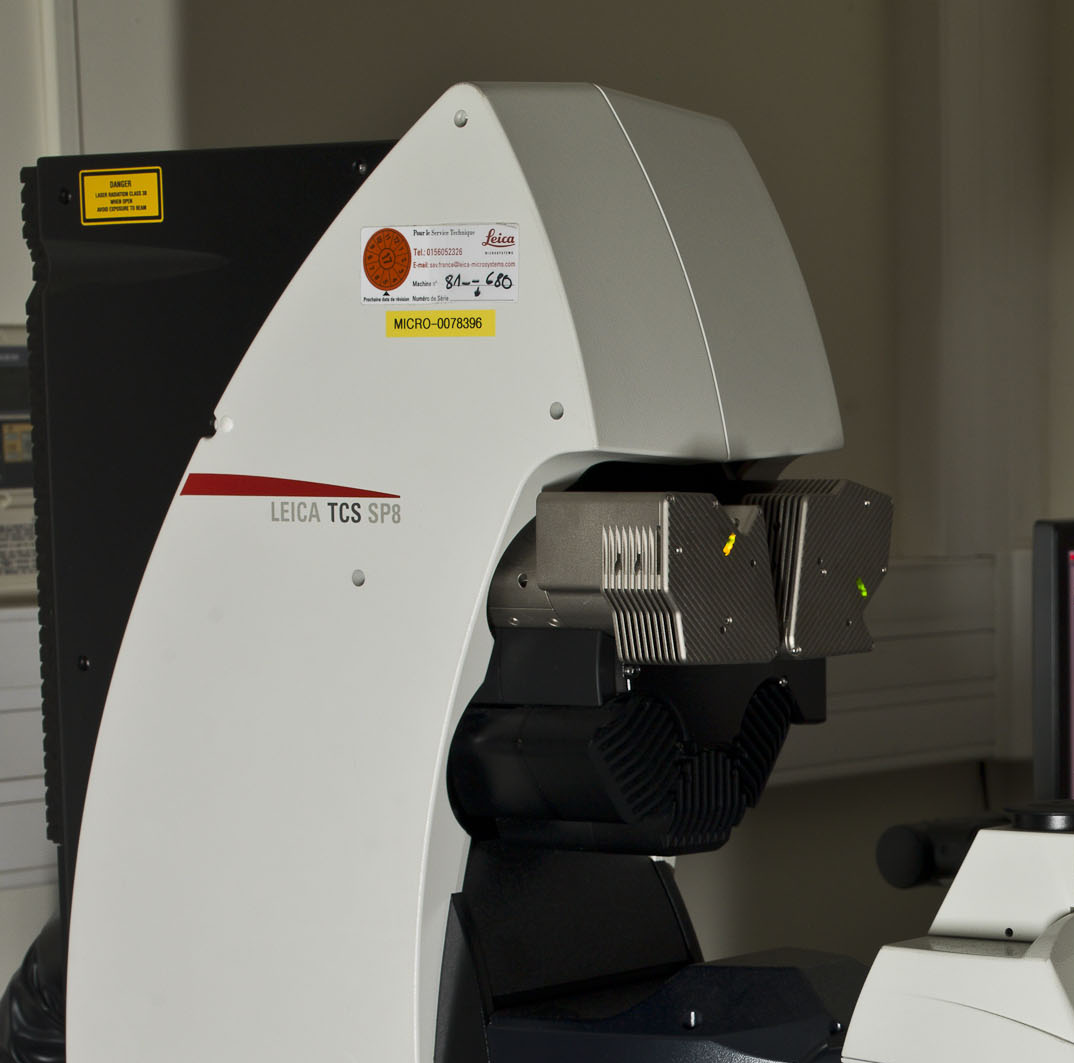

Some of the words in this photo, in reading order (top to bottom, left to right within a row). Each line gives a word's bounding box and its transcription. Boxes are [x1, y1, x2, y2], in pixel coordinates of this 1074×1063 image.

[110, 180, 132, 188] DANGER
[450, 229, 475, 237] Technique
[482, 228, 516, 248] Leica
[426, 248, 463, 256] 0156052326
[394, 318, 482, 329] MICRO-0078396
[271, 502, 320, 523] LEICA
[328, 502, 362, 524] TCS
[368, 503, 401, 524] SP8
